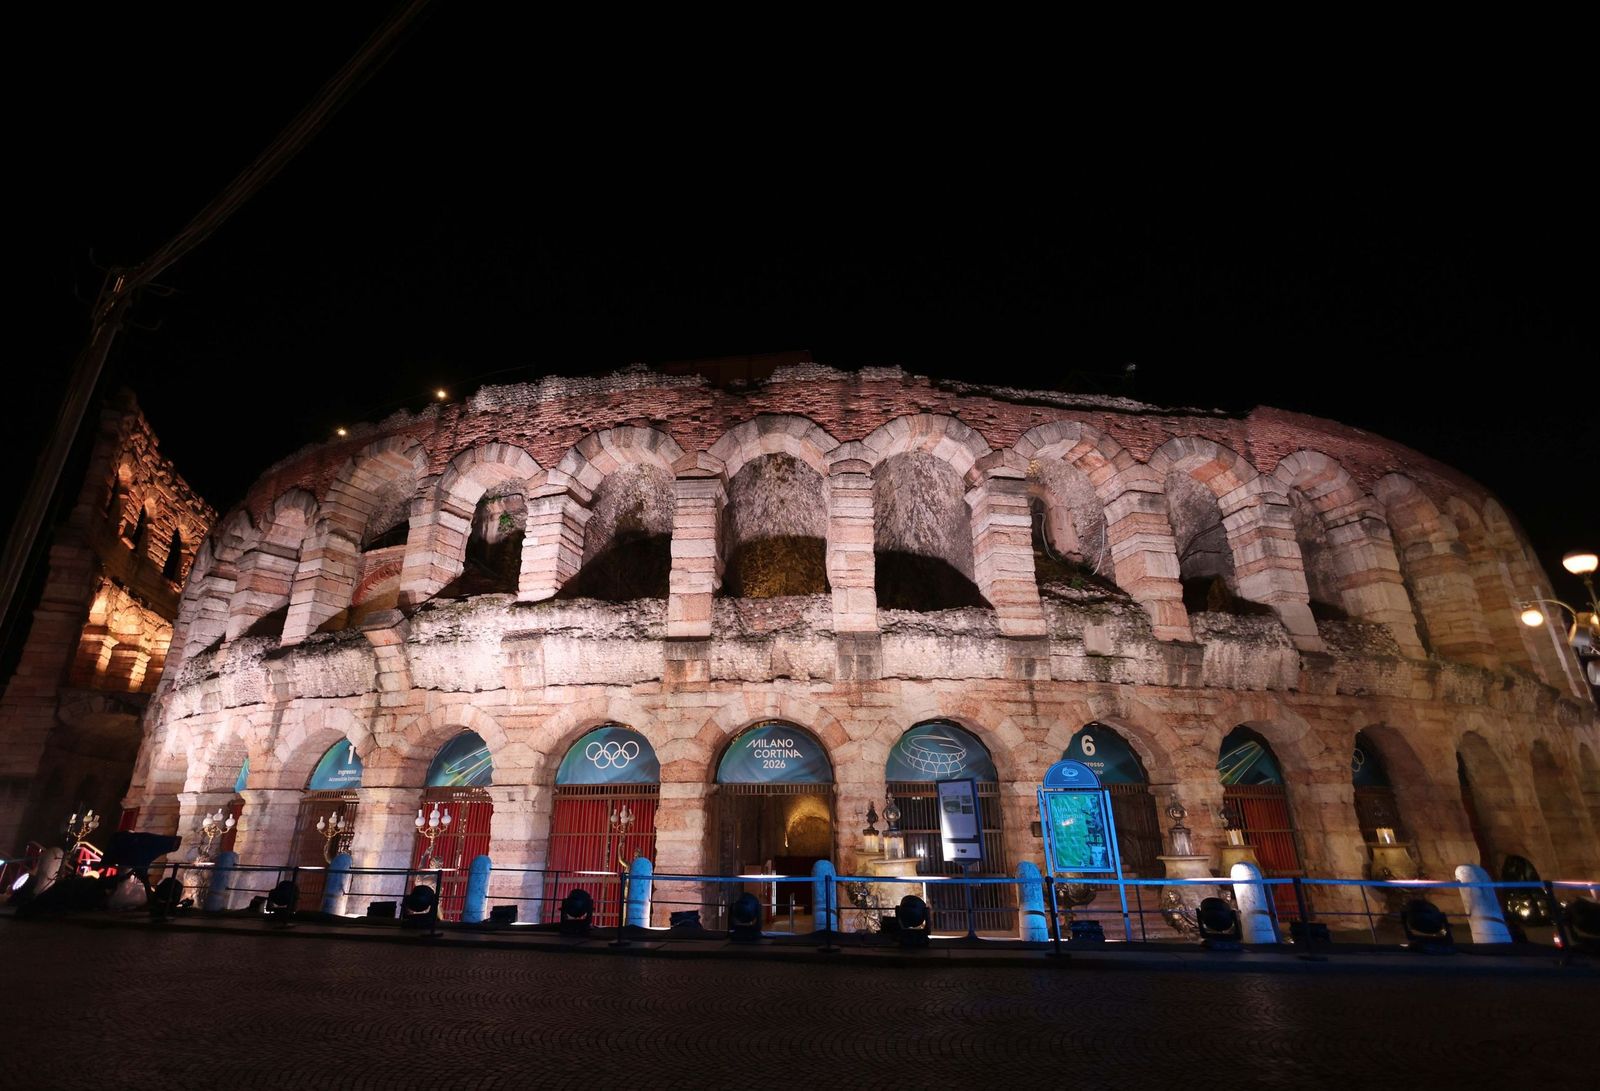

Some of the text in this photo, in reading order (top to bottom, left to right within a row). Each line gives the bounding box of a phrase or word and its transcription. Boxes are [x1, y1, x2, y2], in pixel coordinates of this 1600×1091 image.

[746, 738, 794, 748] MILANO
[1081, 734, 1096, 757] 6
[347, 745, 355, 765] 1
[754, 749, 803, 758] CORTINA
[763, 760, 786, 769] 2026
